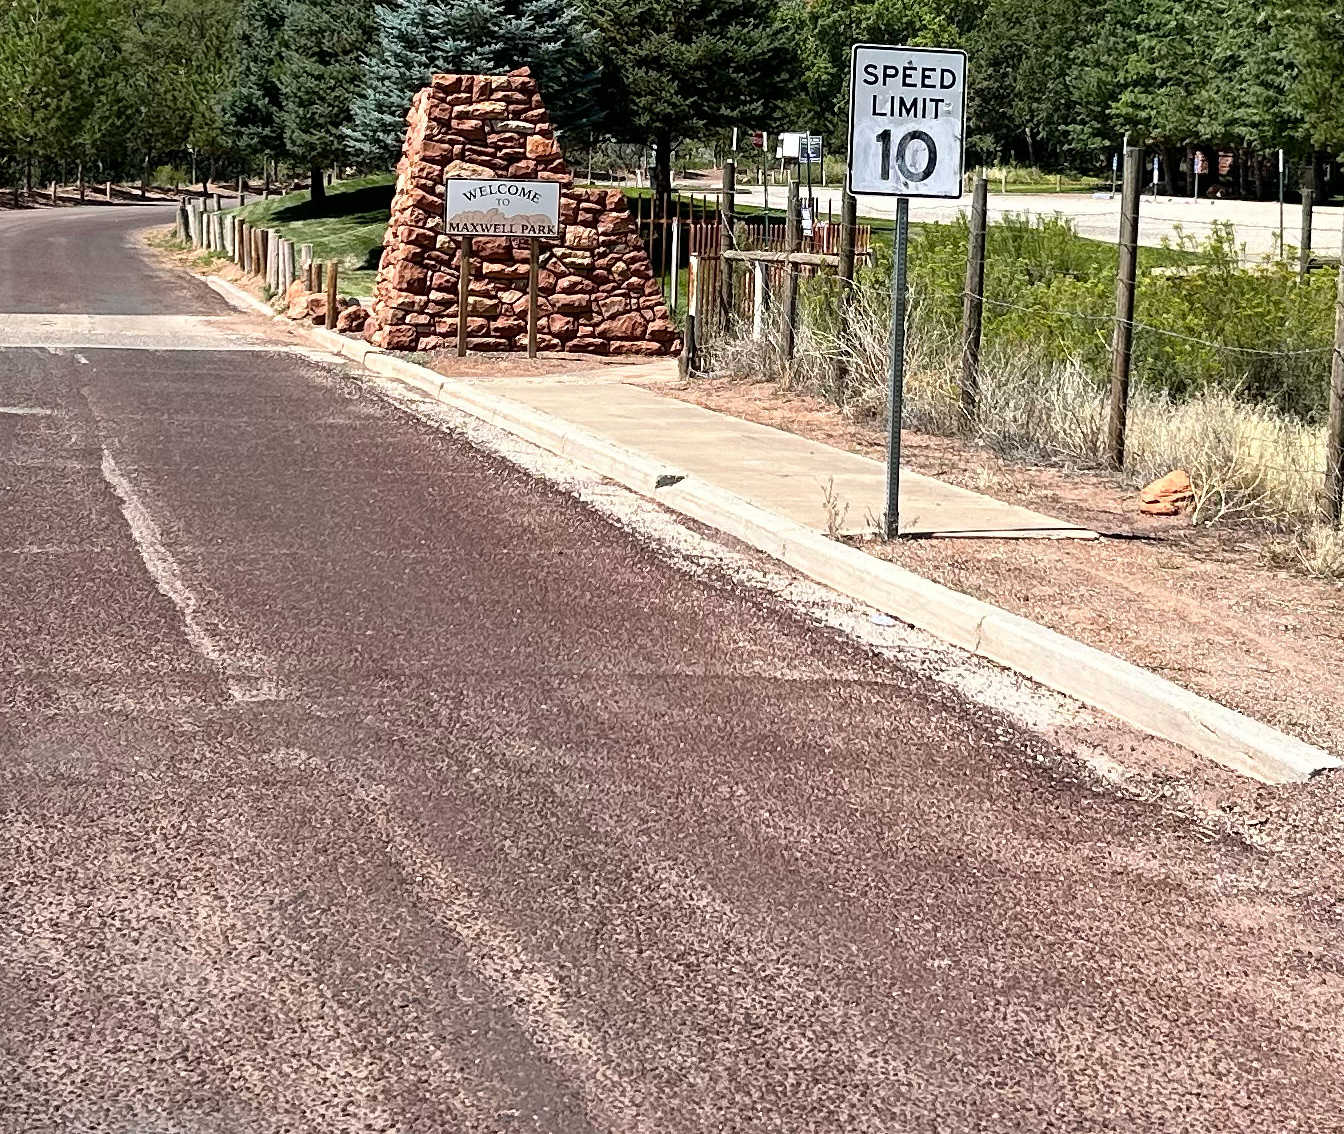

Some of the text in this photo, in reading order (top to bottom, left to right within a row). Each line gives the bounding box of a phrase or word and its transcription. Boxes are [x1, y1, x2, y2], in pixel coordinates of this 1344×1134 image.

[863, 63, 956, 90] SPEED
[872, 94, 945, 120] LIMIT
[876, 129, 937, 182] 10
[462, 183, 542, 205] WELCOME
[496, 197, 511, 207] TO
[448, 222, 556, 235] MAXWELL PARK
